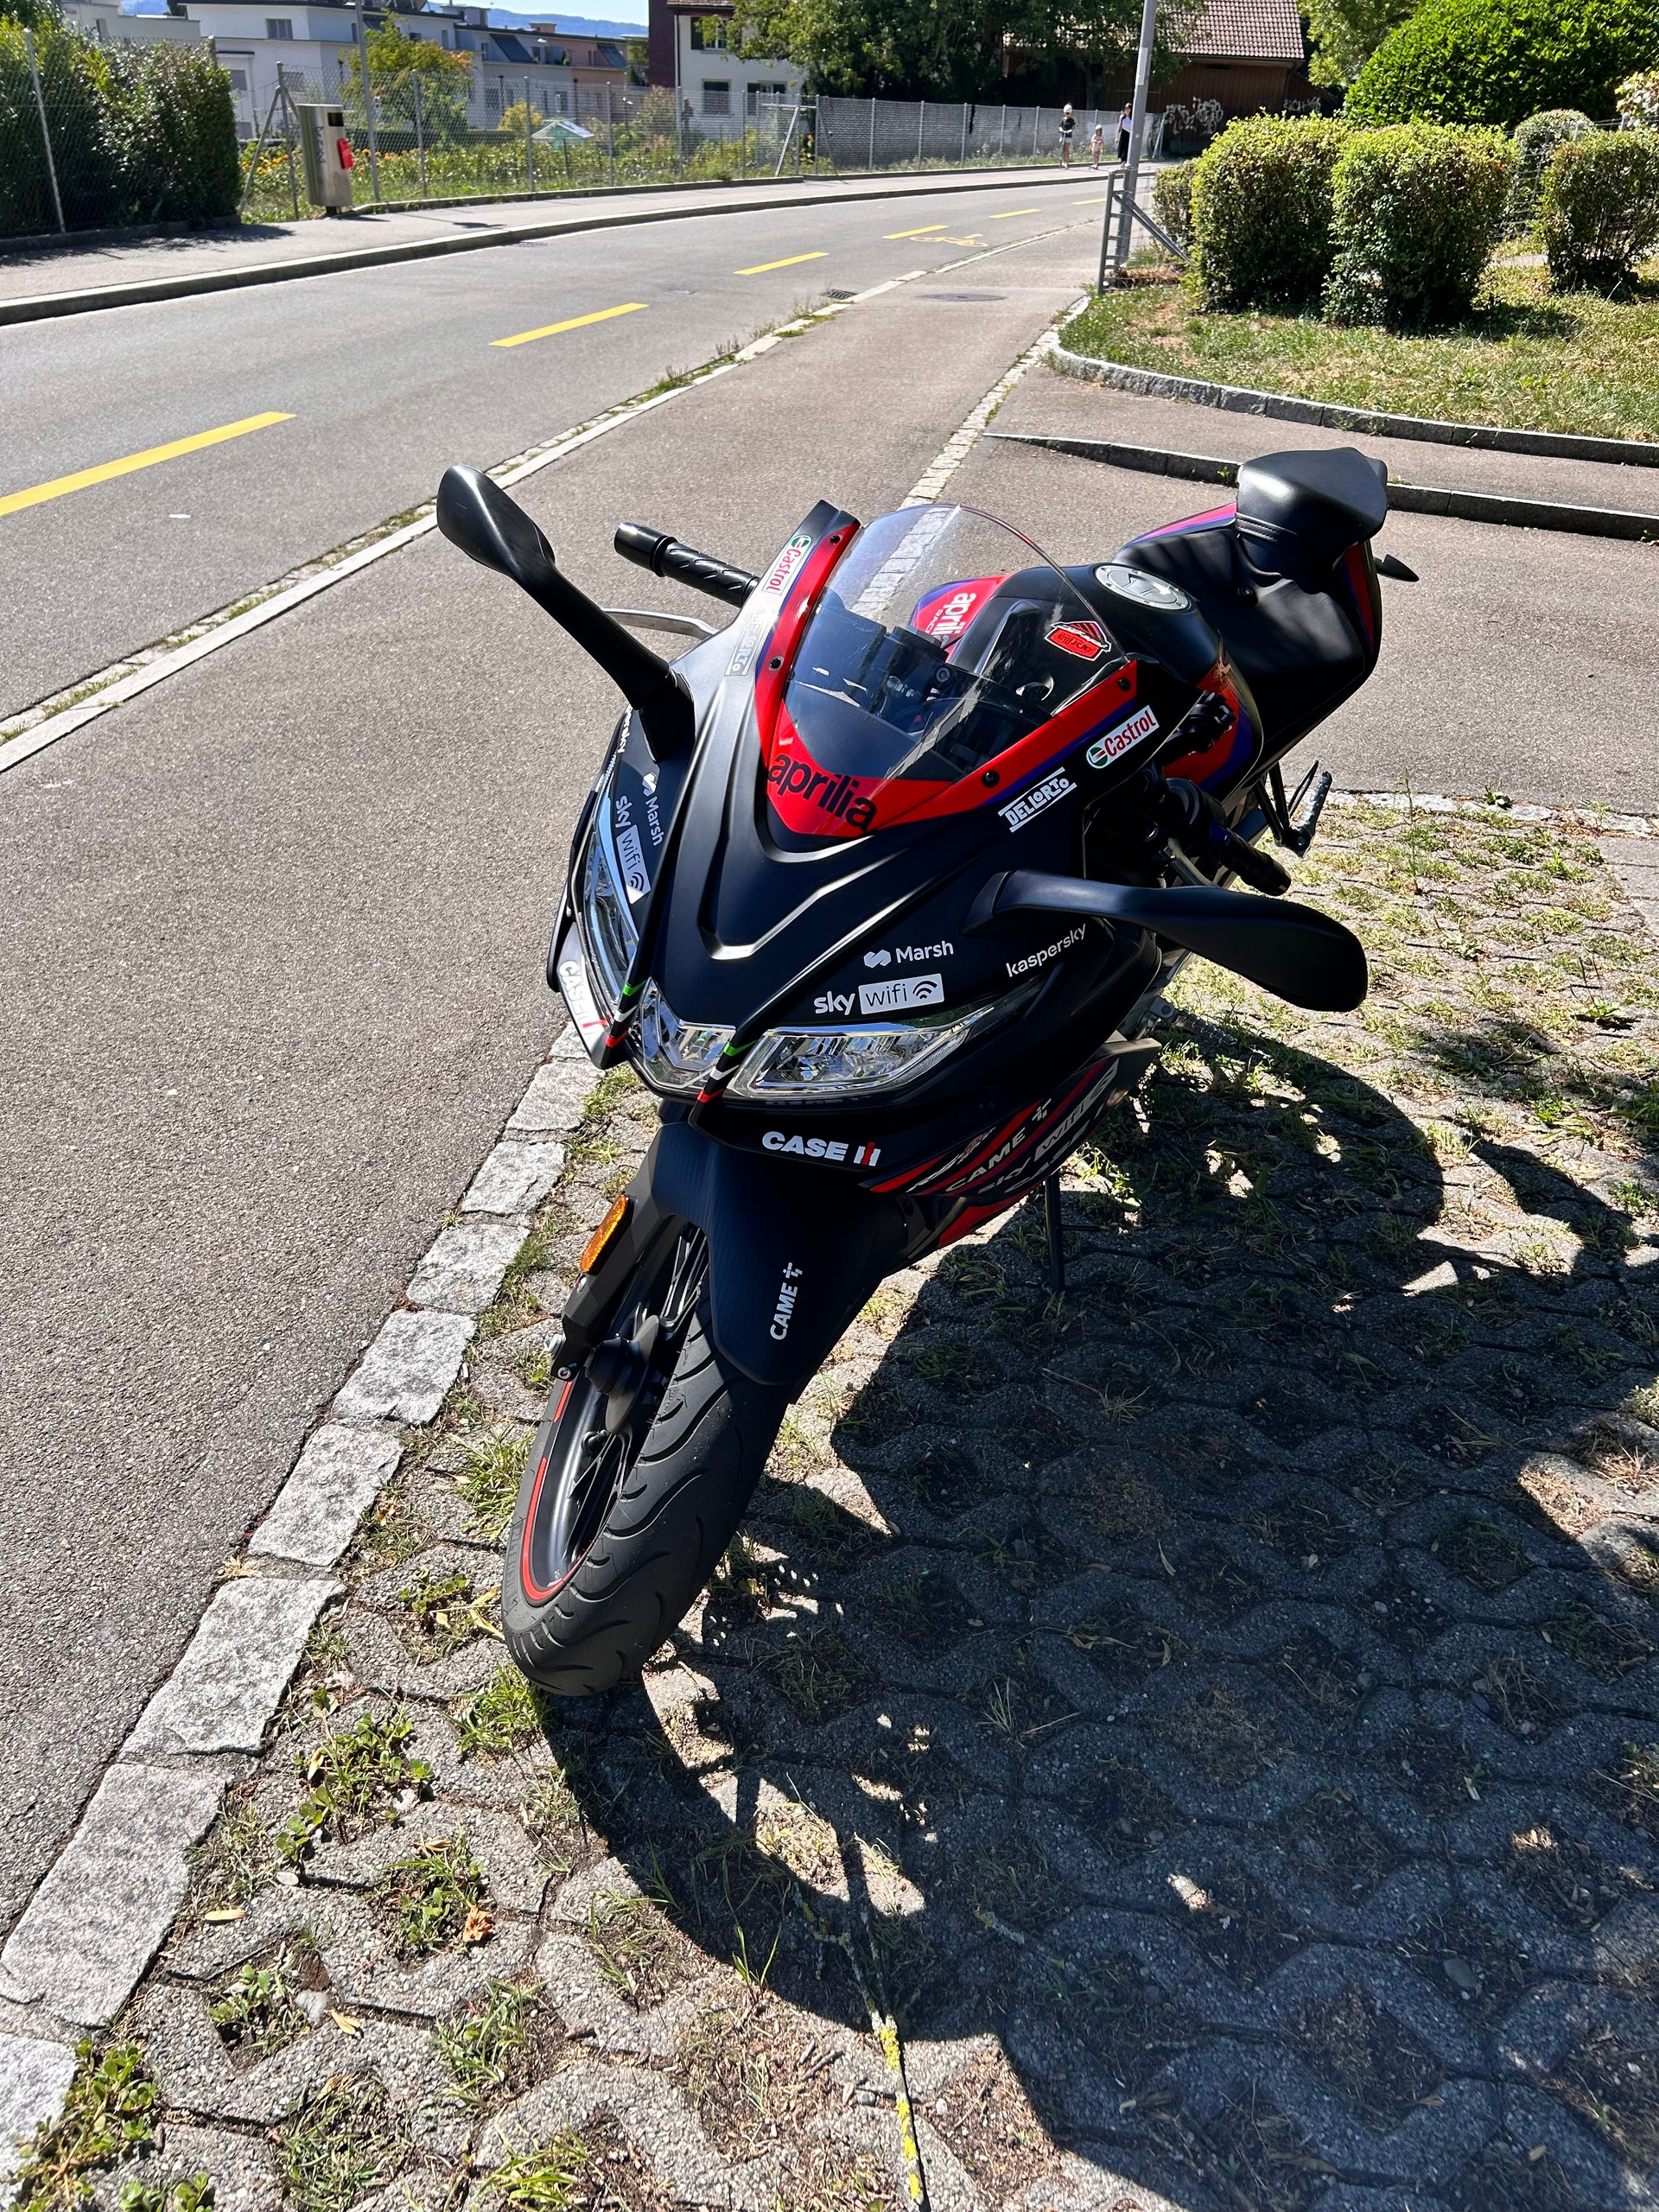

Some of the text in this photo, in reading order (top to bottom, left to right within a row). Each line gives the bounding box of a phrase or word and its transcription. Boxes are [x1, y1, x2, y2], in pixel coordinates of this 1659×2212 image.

[766, 549, 802, 591] Castrol
[1057, 633, 1093, 653] aprilia
[1104, 710, 1156, 757] Castrol
[767, 754, 877, 832] aprilia
[1005, 778, 1070, 826] DELLORTO
[615, 795, 641, 870] sky wifi
[645, 796, 664, 846] Marsh
[895, 940, 954, 963] Marsh
[1006, 924, 1086, 977] kaspersky
[813, 982, 908, 1015] sky wifi
[761, 1131, 849, 1161] CASE
[1041, 1103, 1085, 1150] wifi
[945, 1127, 1027, 1192] CAME
[770, 1282, 798, 1340] CAME
